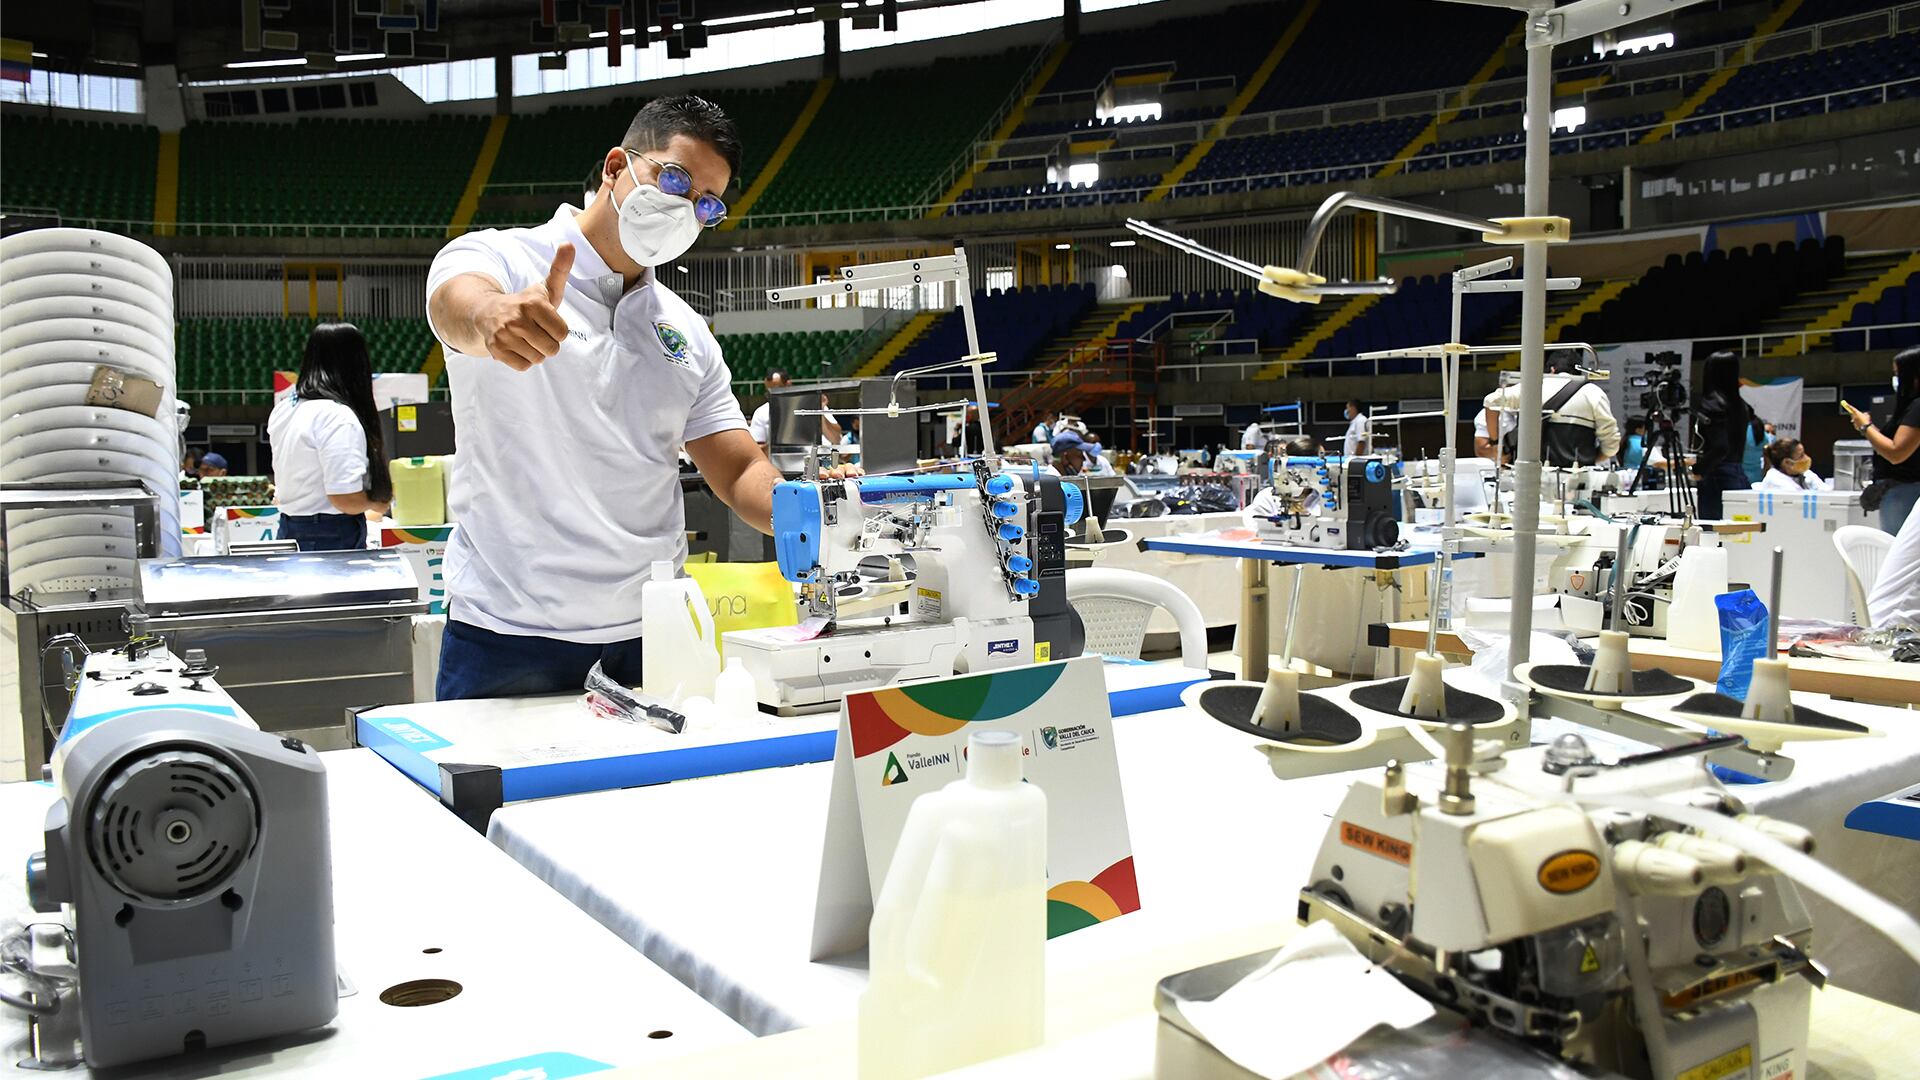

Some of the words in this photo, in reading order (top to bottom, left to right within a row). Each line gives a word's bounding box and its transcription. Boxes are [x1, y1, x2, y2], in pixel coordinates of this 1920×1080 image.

[706, 595, 747, 617] una
[1080, 728, 1095, 736] CAUCA
[908, 752, 950, 770] ValleINN
[1345, 826, 1374, 848] SEW
[1376, 837, 1410, 860] KING
[1548, 867, 1570, 882] SEW
[1571, 860, 1596, 876] KING
[1765, 1059, 1790, 1077] KING
